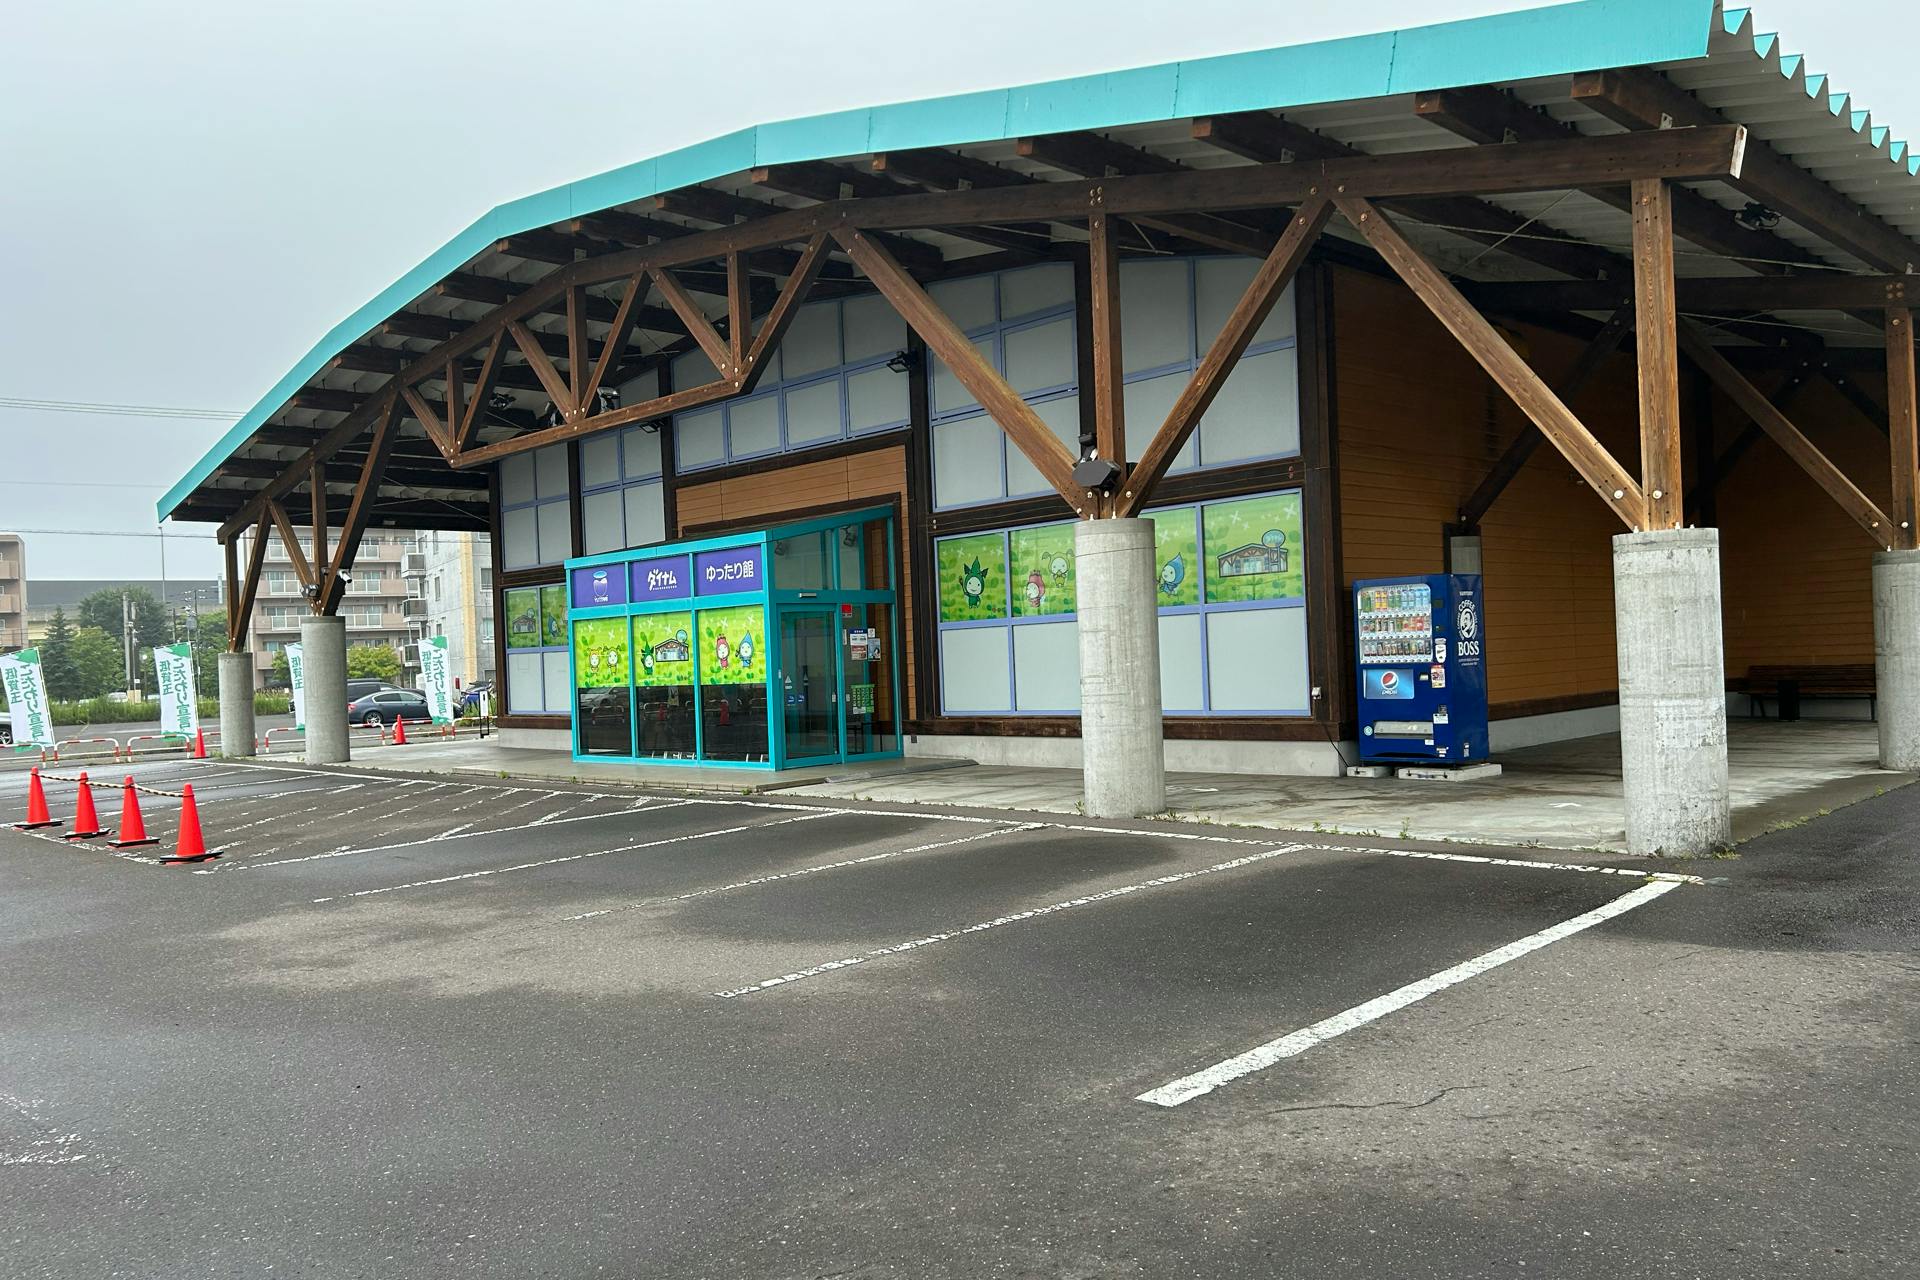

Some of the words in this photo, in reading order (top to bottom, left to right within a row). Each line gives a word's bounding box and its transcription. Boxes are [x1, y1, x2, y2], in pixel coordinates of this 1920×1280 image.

[648, 569, 677, 590] ダイナム
[706, 560, 754, 582] ゆったり館
[1458, 641, 1479, 656] BOSS
